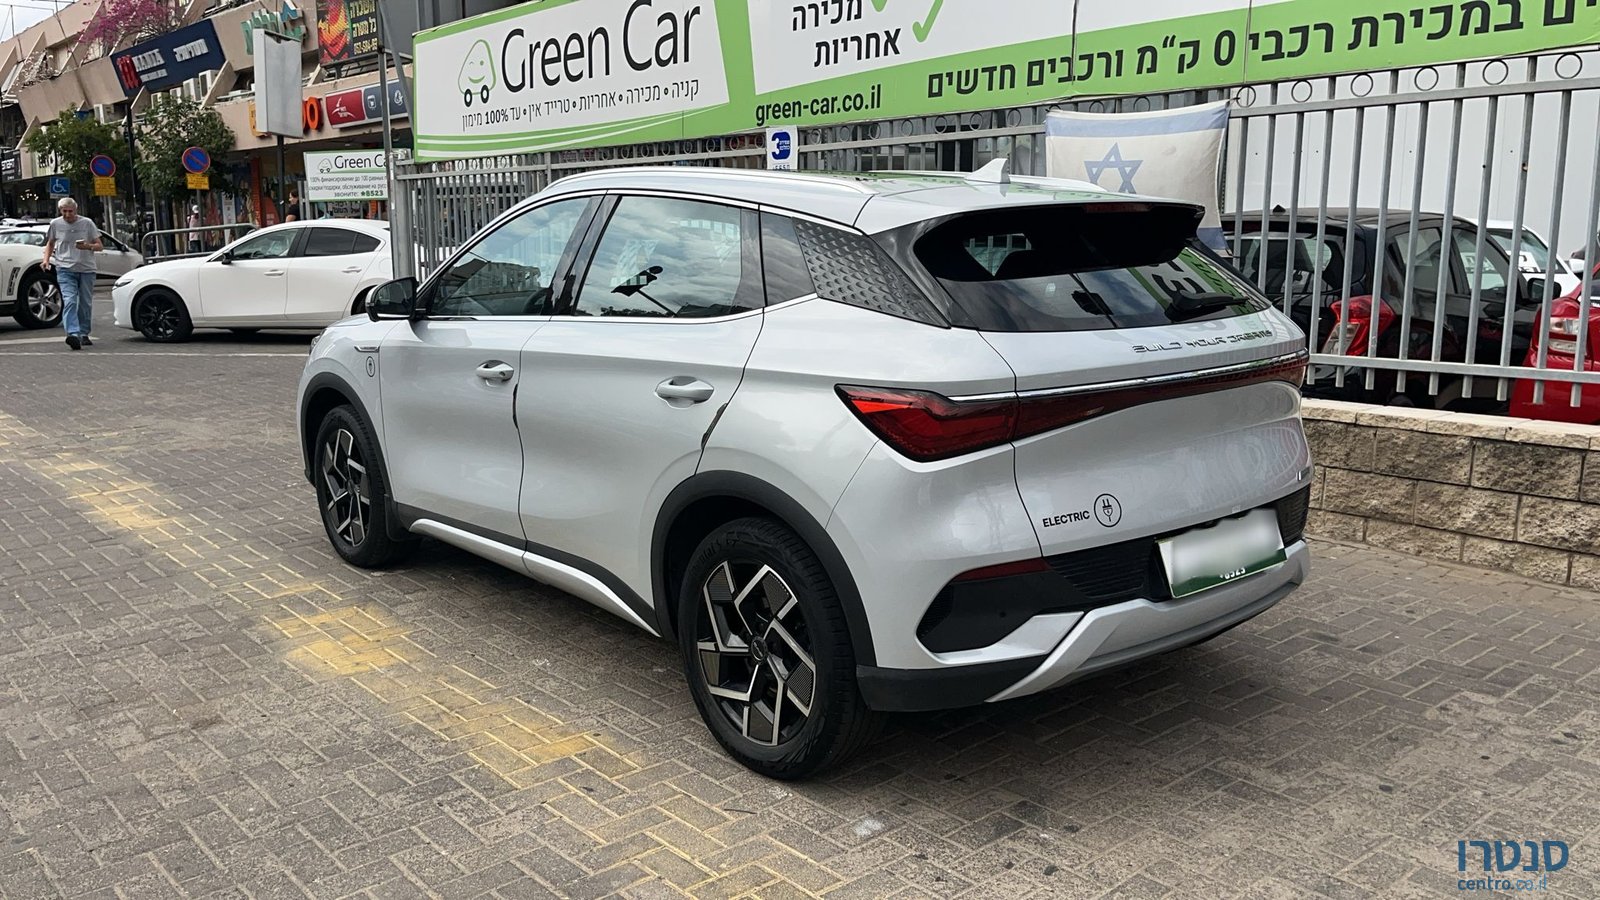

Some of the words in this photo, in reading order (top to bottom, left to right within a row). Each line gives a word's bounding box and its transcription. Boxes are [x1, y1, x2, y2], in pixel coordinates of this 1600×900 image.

[793, 0, 862, 31] מכירה
[1348, 0, 1524, 50] במכירת
[501, 26, 610, 93] Green
[623, 0, 700, 71] Car
[814, 28, 901, 67] אחריות
[1213, 29, 1236, 66] 0
[1248, 22, 1334, 61] רכבי
[1026, 49, 1123, 87] ורכבים
[671, 79, 699, 101] קניה
[927, 64, 1016, 98] חדשים
[578, 91, 616, 111] אחריות
[626, 85, 661, 105] מכירה
[755, 84, 882, 126] green-car.co.il
[485, 109, 509, 125] 100%
[510, 106, 521, 122] עד
[528, 102, 542, 122] אין
[544, 98, 571, 116] טרייד
[462, 112, 483, 131] מימון
[334, 155, 372, 169] Green
[1132, 341, 1183, 353] BUILD
[1185, 336, 1224, 348] YOUR
[1042, 510, 1091, 528] ELECTRIC
